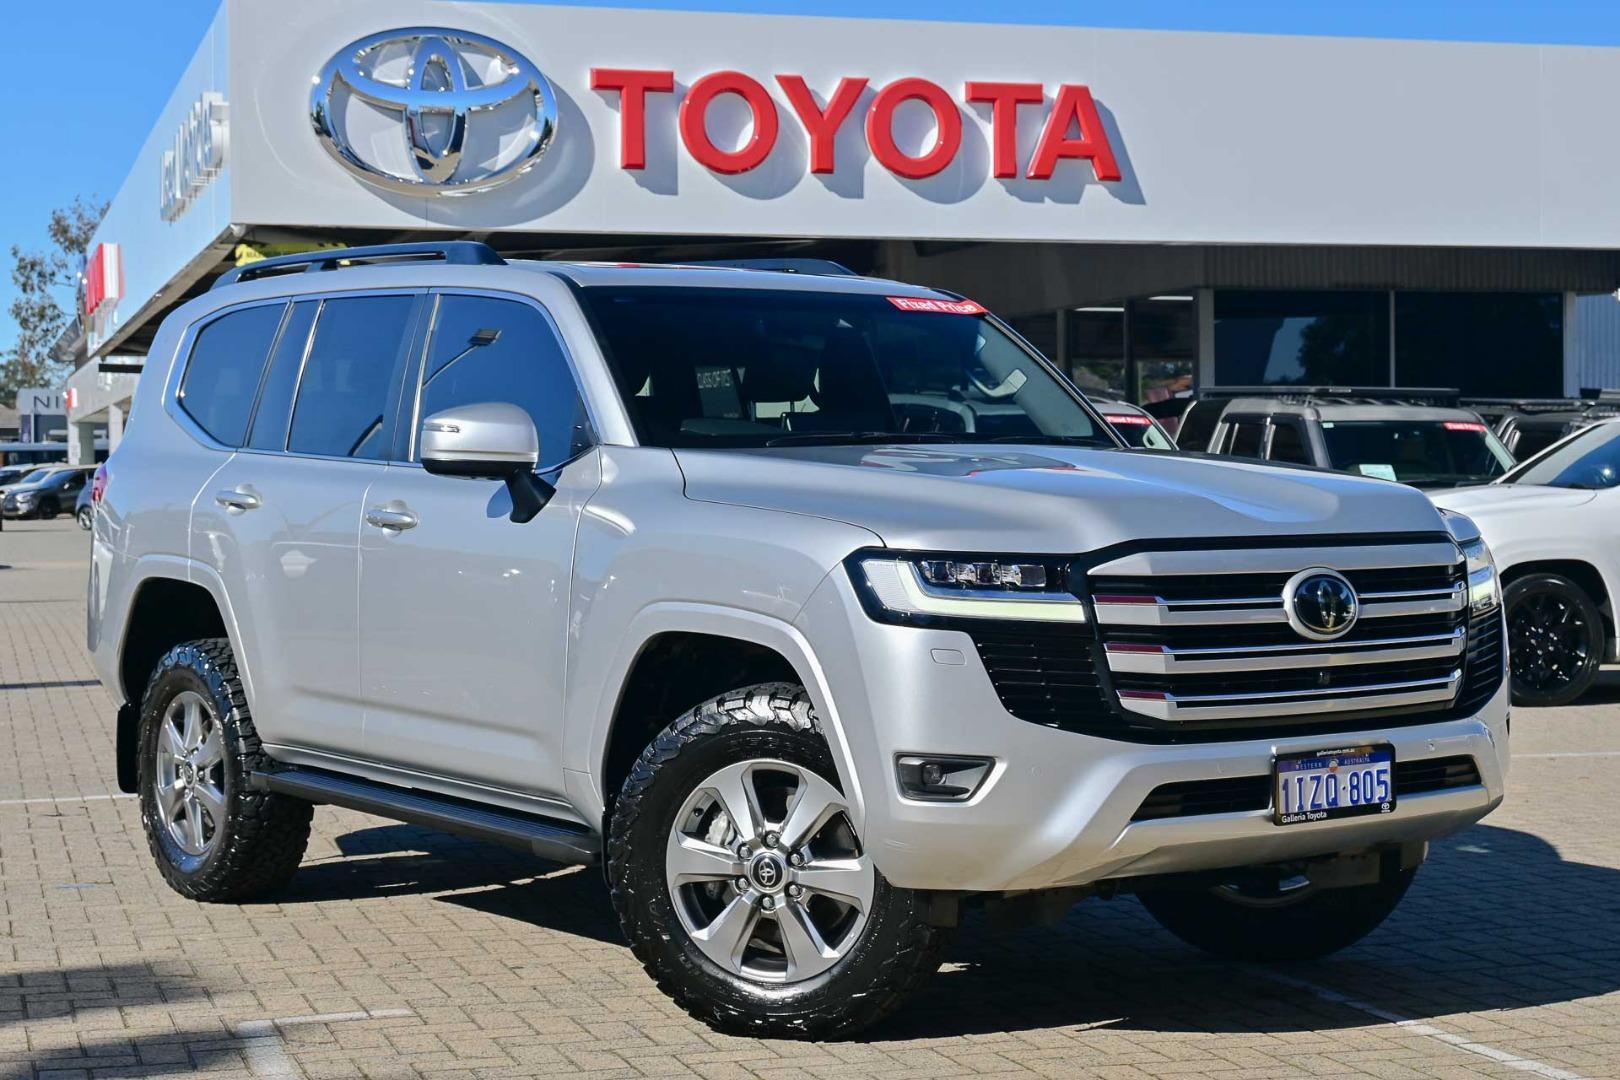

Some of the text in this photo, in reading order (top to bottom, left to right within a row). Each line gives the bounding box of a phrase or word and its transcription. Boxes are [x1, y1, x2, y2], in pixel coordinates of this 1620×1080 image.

[590, 68, 1122, 181] TOYOTA
[896, 299, 977, 312] Fixed Price
[1282, 811, 1327, 823] Galleria Toyota
